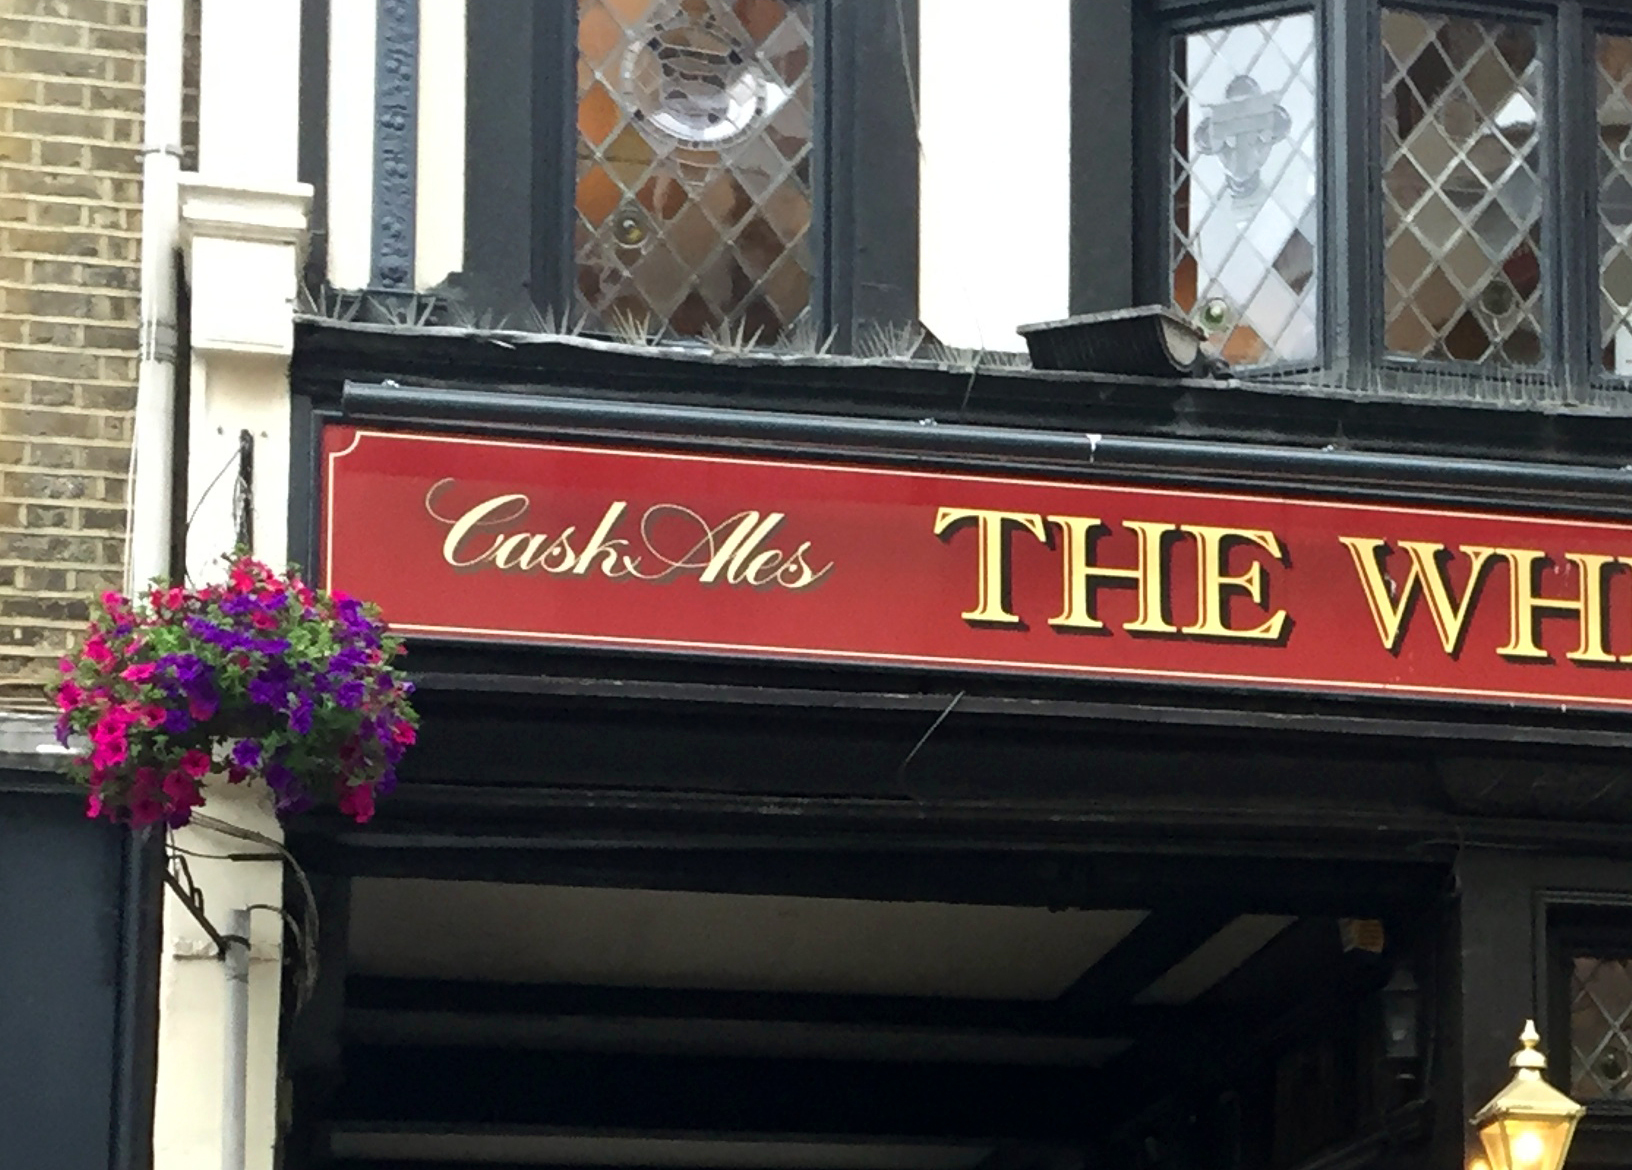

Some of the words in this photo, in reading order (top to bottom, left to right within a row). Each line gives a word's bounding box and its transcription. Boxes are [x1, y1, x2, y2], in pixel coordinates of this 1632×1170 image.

[425, 477, 643, 578] Cask
[641, 502, 834, 588] Ales
[934, 506, 1293, 642] THE
